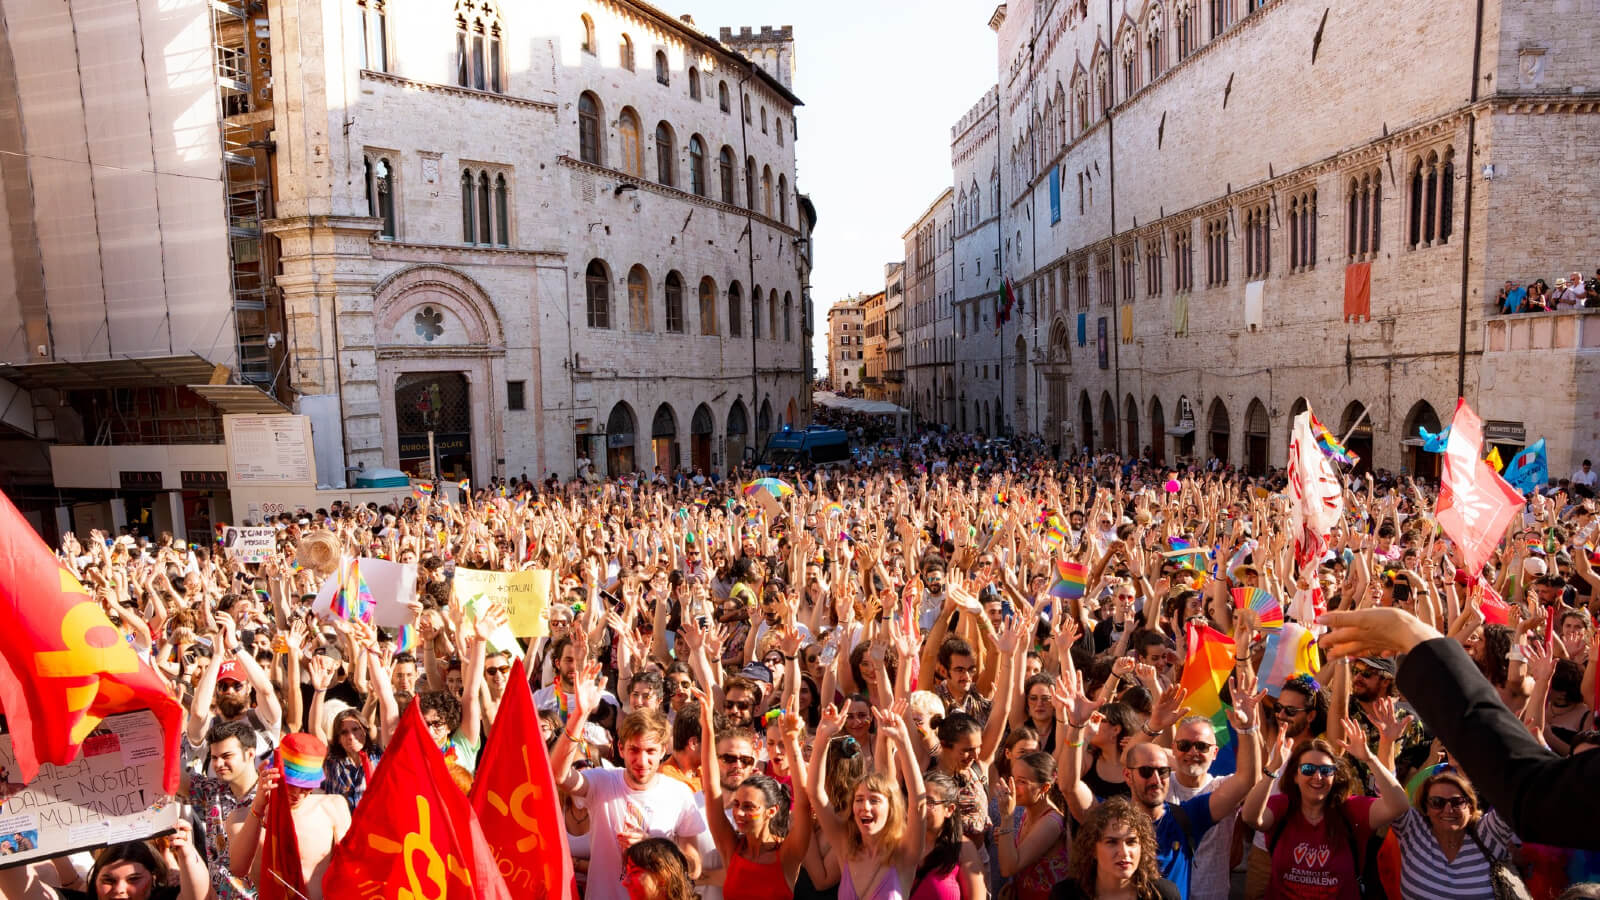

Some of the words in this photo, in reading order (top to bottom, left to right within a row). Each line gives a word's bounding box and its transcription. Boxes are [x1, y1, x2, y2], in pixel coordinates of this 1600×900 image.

[30, 759, 91, 785] HIESA
[7, 784, 72, 815] DALLE
[78, 764, 150, 797] NOSTRE
[40, 789, 148, 833] MUTANDE!
[1283, 873, 1339, 886] ARCOBALENO
[1291, 868, 1330, 878] FAMIGLIE
